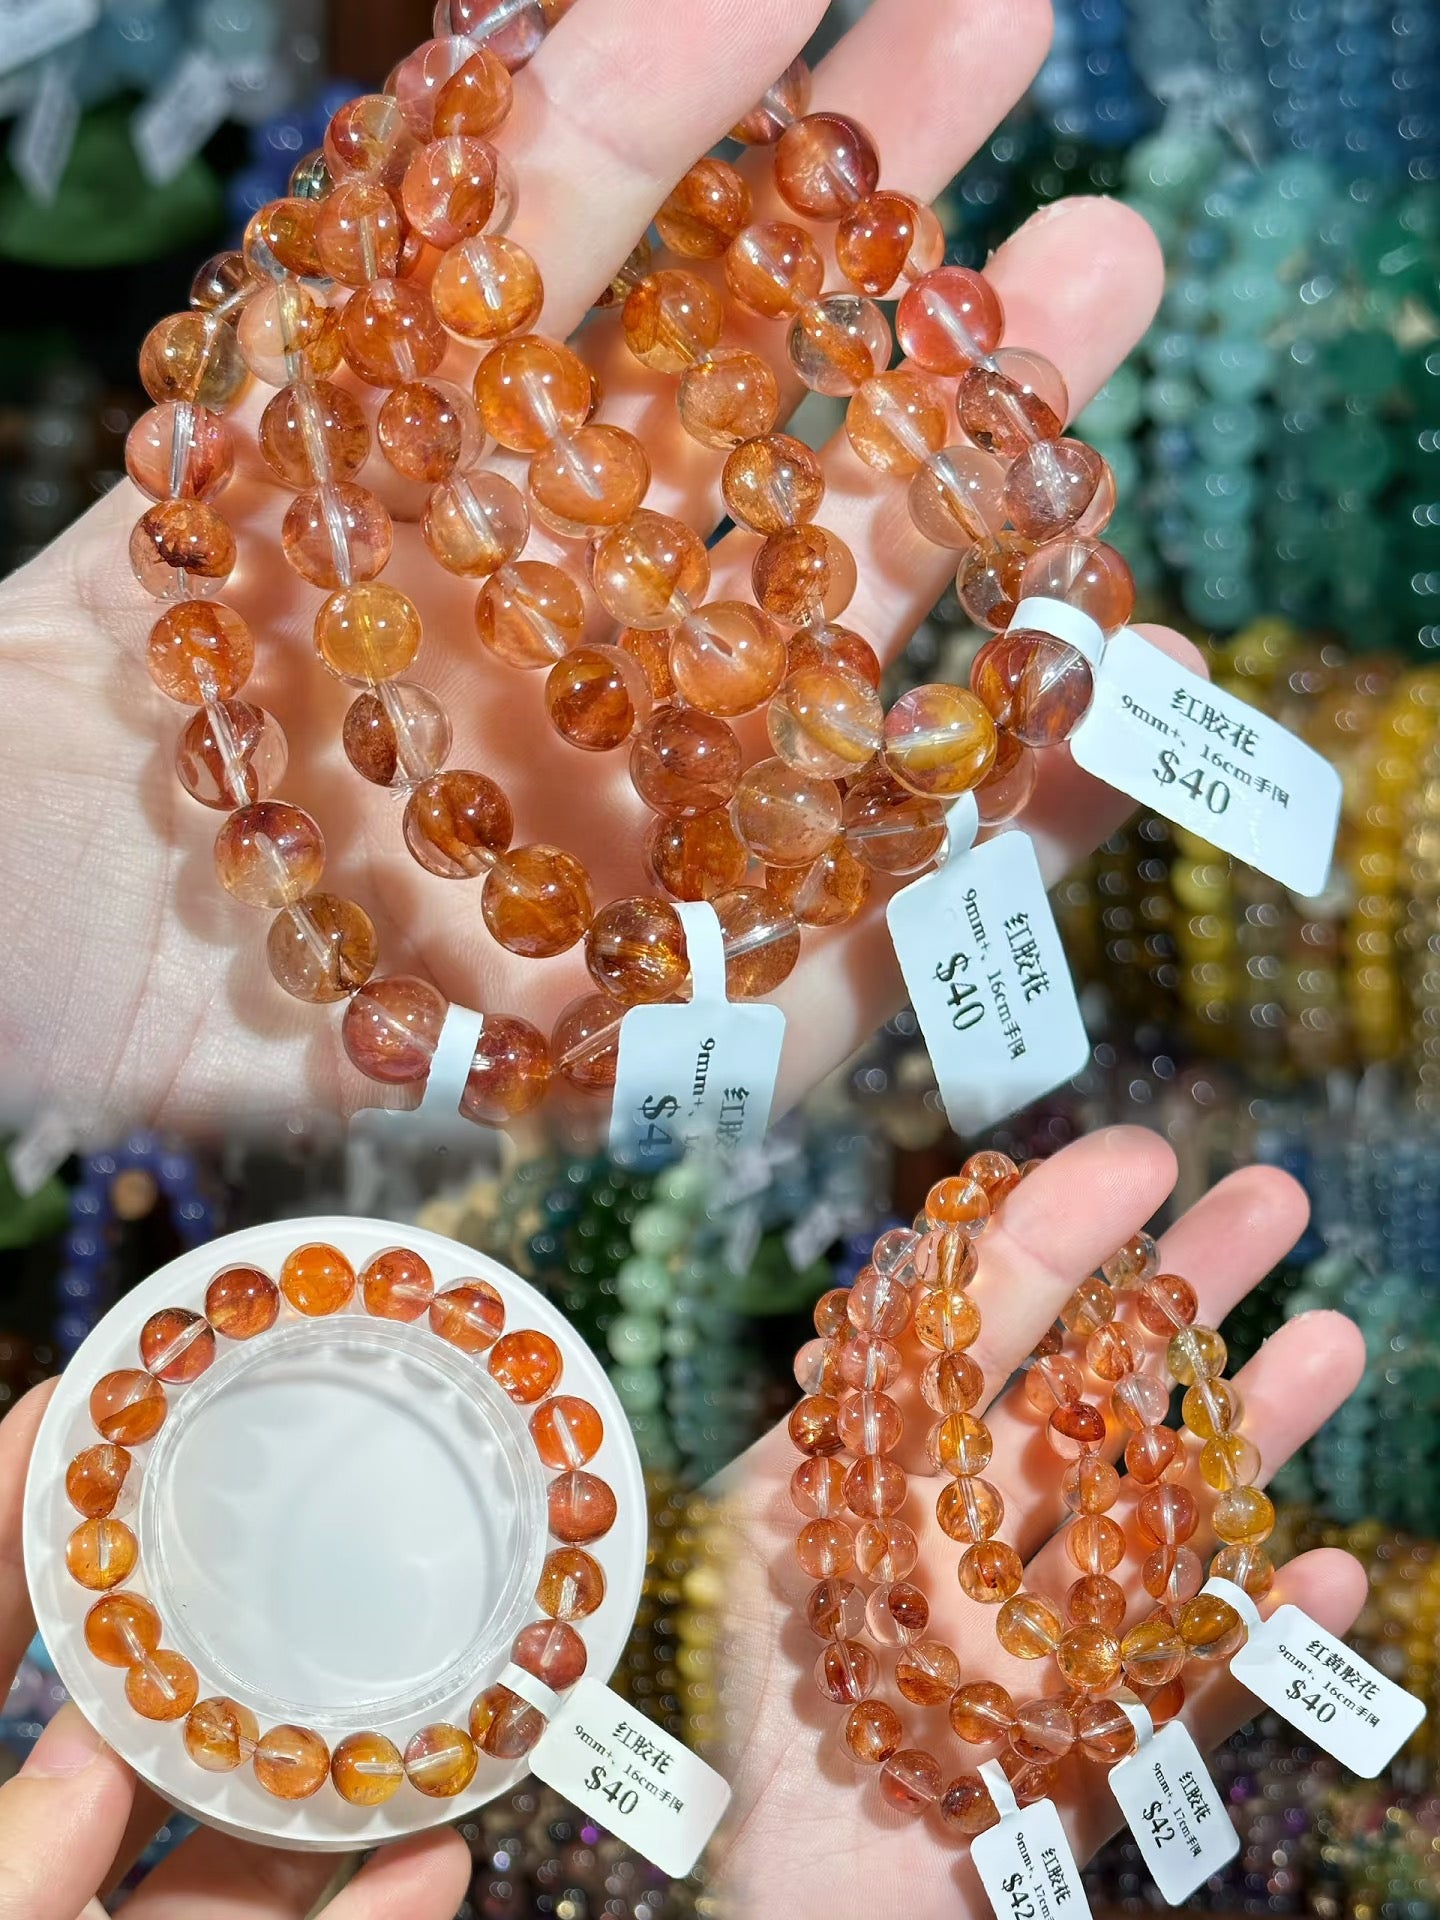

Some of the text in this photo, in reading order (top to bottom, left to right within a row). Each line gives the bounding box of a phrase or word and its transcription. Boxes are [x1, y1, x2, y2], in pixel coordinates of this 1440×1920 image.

[1170, 688, 1259, 757] 红胶花
[1152, 748, 1230, 814] $40
[1003, 912, 1050, 1004] 红胶花
[932, 951, 985, 1031] $40
[1305, 1639, 1381, 1701] 红黄胶花
[1285, 1679, 1336, 1723] $40
[612, 1721, 674, 1775] 红胶花
[584, 1764, 639, 1815] $40
[1178, 1771, 1211, 1823] 红胶花
[1142, 1800, 1175, 1849] $42
[1001, 1872, 1035, 1920] $42
[1041, 1847, 1071, 1906] 红胶花
